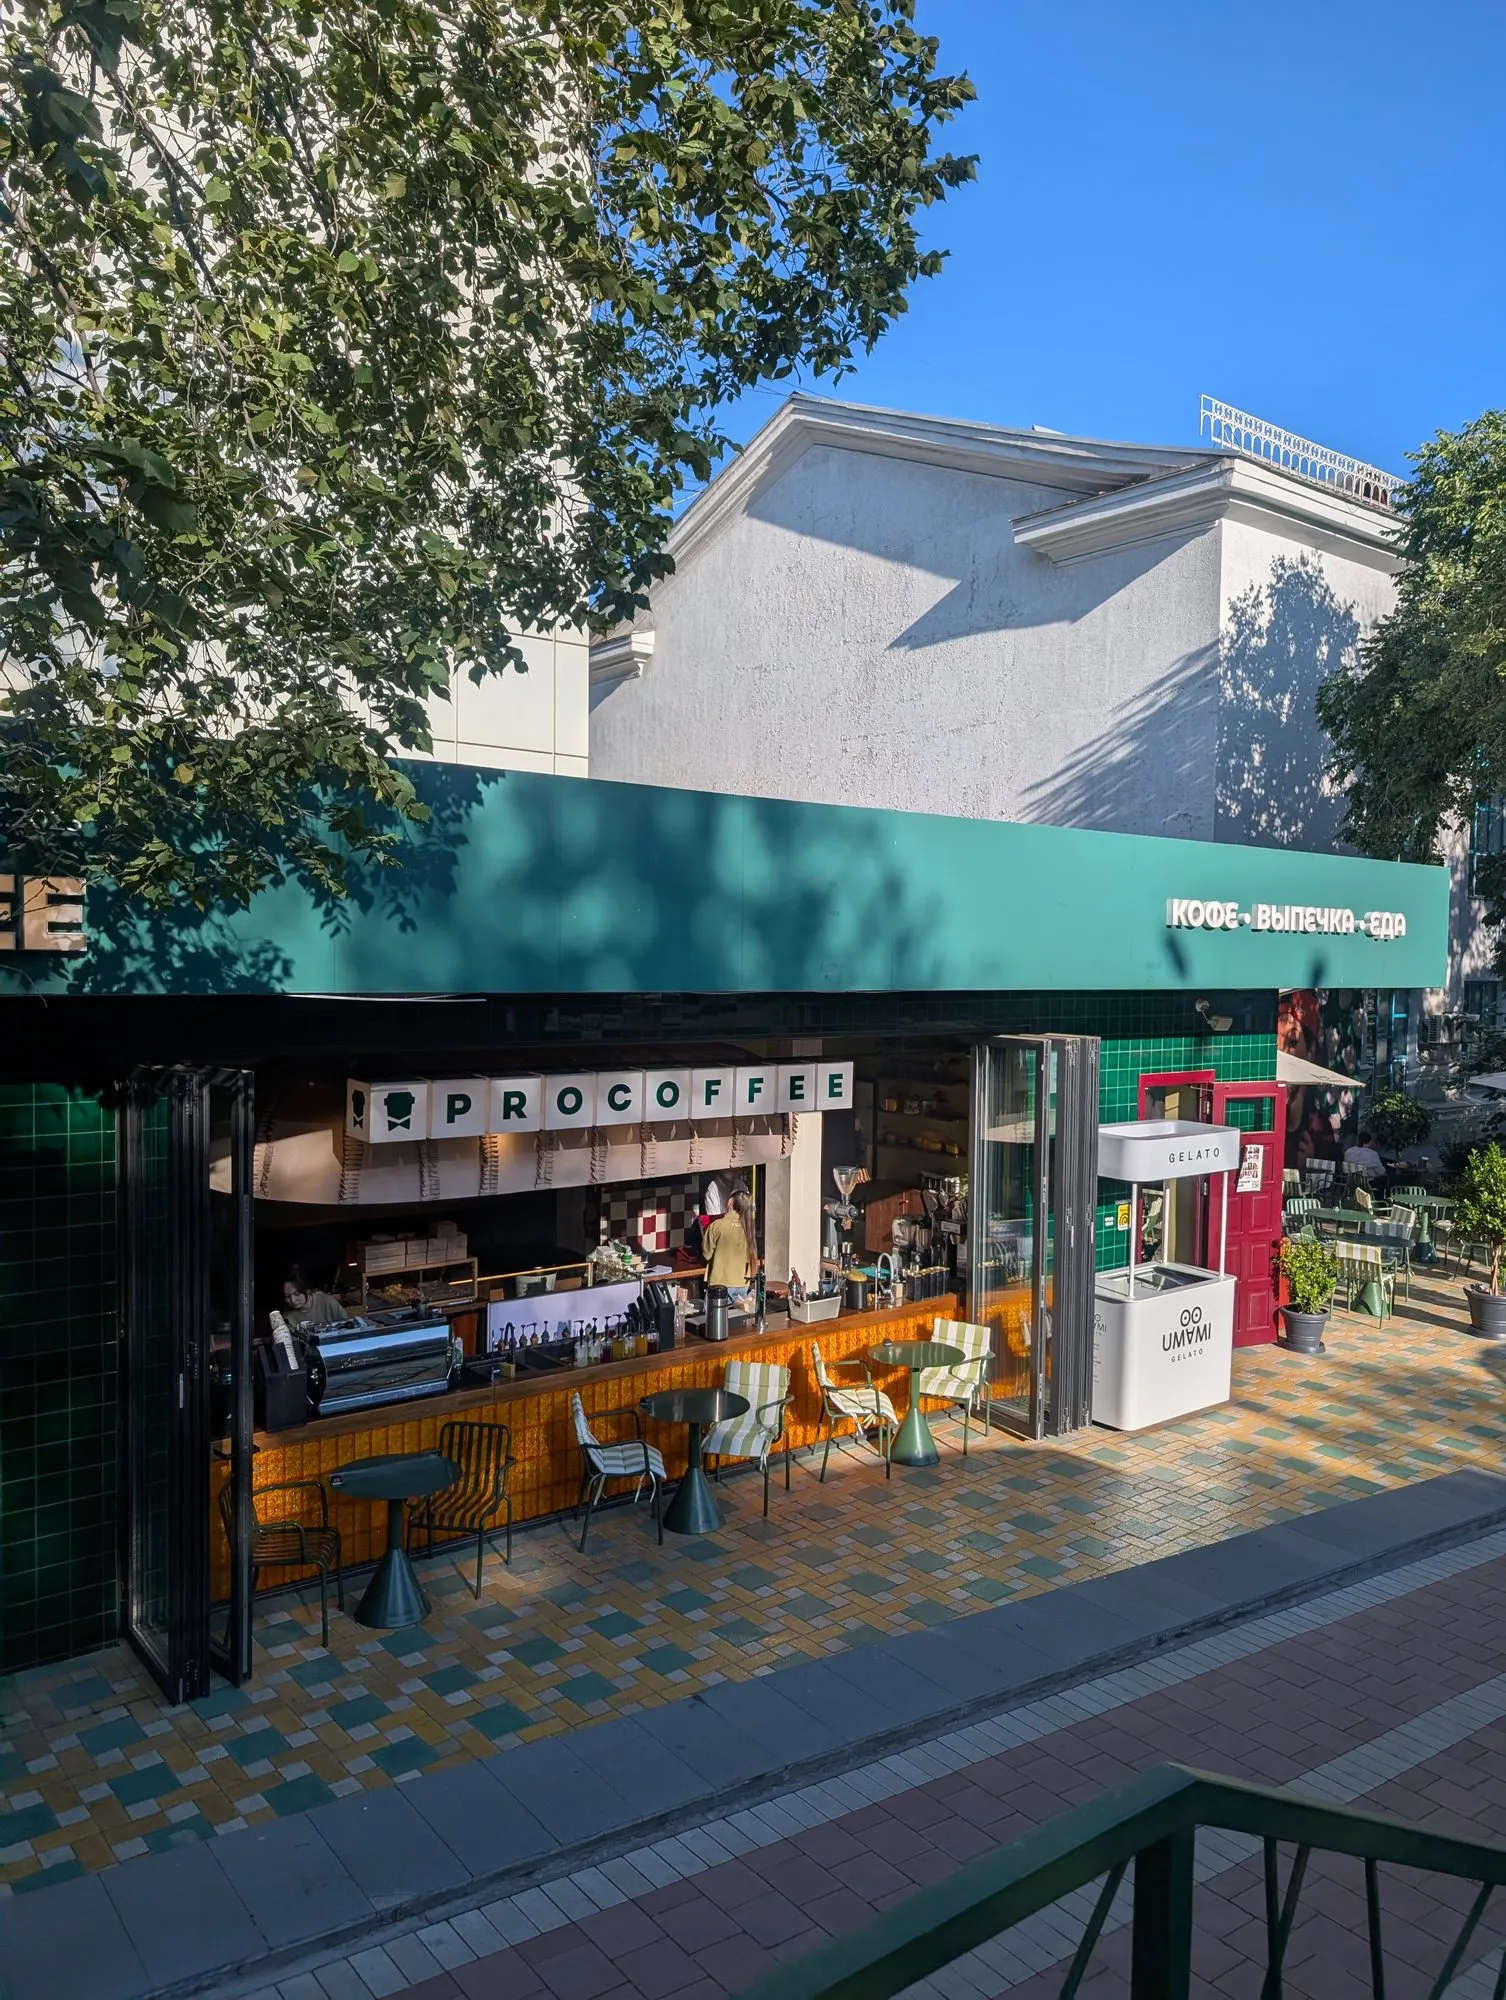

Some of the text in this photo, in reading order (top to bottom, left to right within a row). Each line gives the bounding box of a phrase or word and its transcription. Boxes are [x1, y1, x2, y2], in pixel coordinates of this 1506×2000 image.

[1168, 899, 1406, 939] КОФЕ ВЫПЕЧКА ЕДА
[446, 1073, 843, 1124] PROCOFFEE
[1168, 1147, 1220, 1163] GELATO
[1171, 1348, 1203, 1362] GELATO
